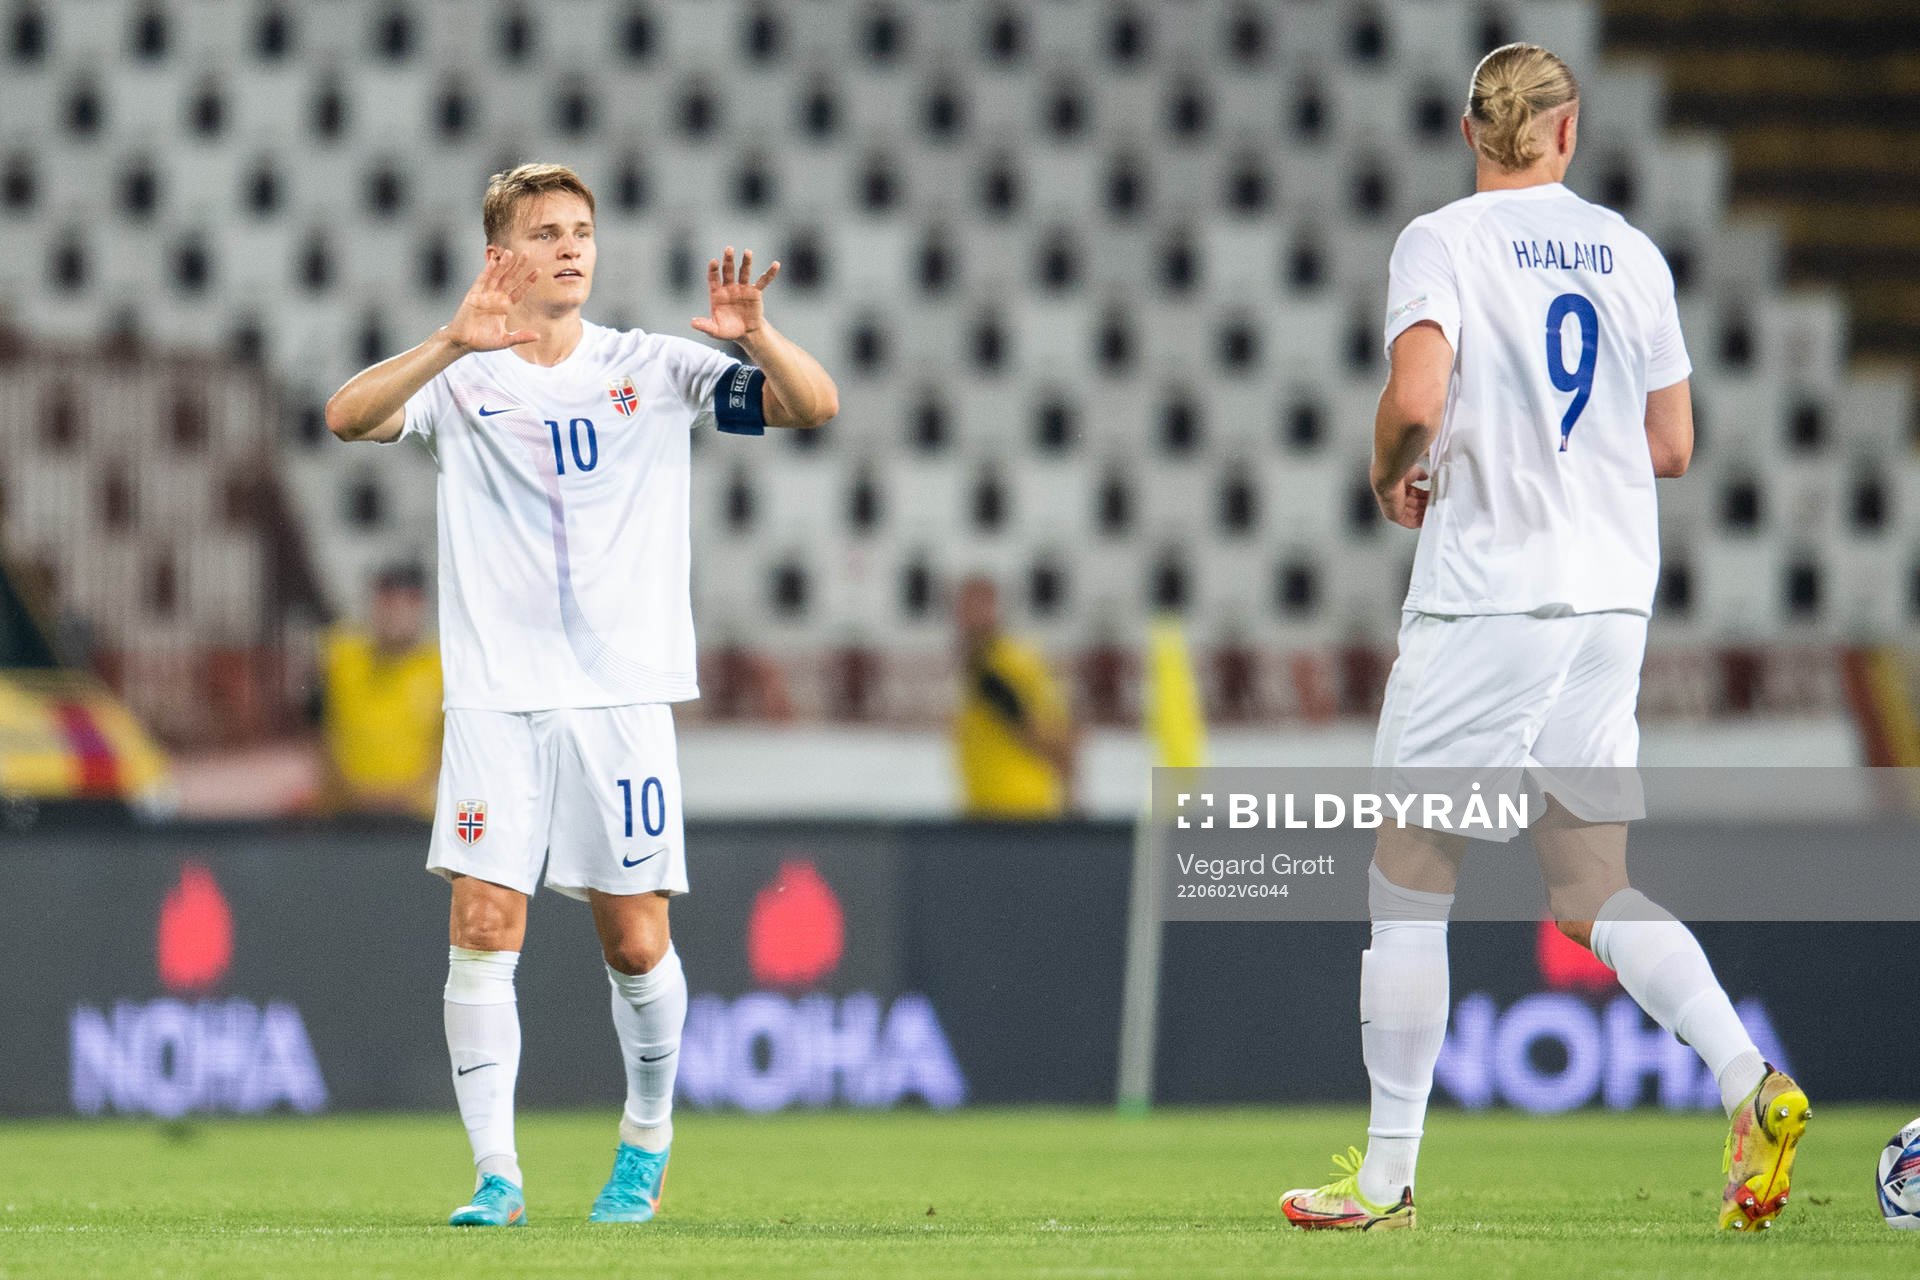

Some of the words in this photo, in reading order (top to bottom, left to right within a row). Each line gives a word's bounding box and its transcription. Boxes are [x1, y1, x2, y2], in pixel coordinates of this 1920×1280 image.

[1512, 239, 1614, 275] HAALAND
[1545, 292, 1599, 452] 9
[544, 417, 598, 475] 10
[616, 776, 666, 838] 10
[69, 998, 329, 1116] NOHA
